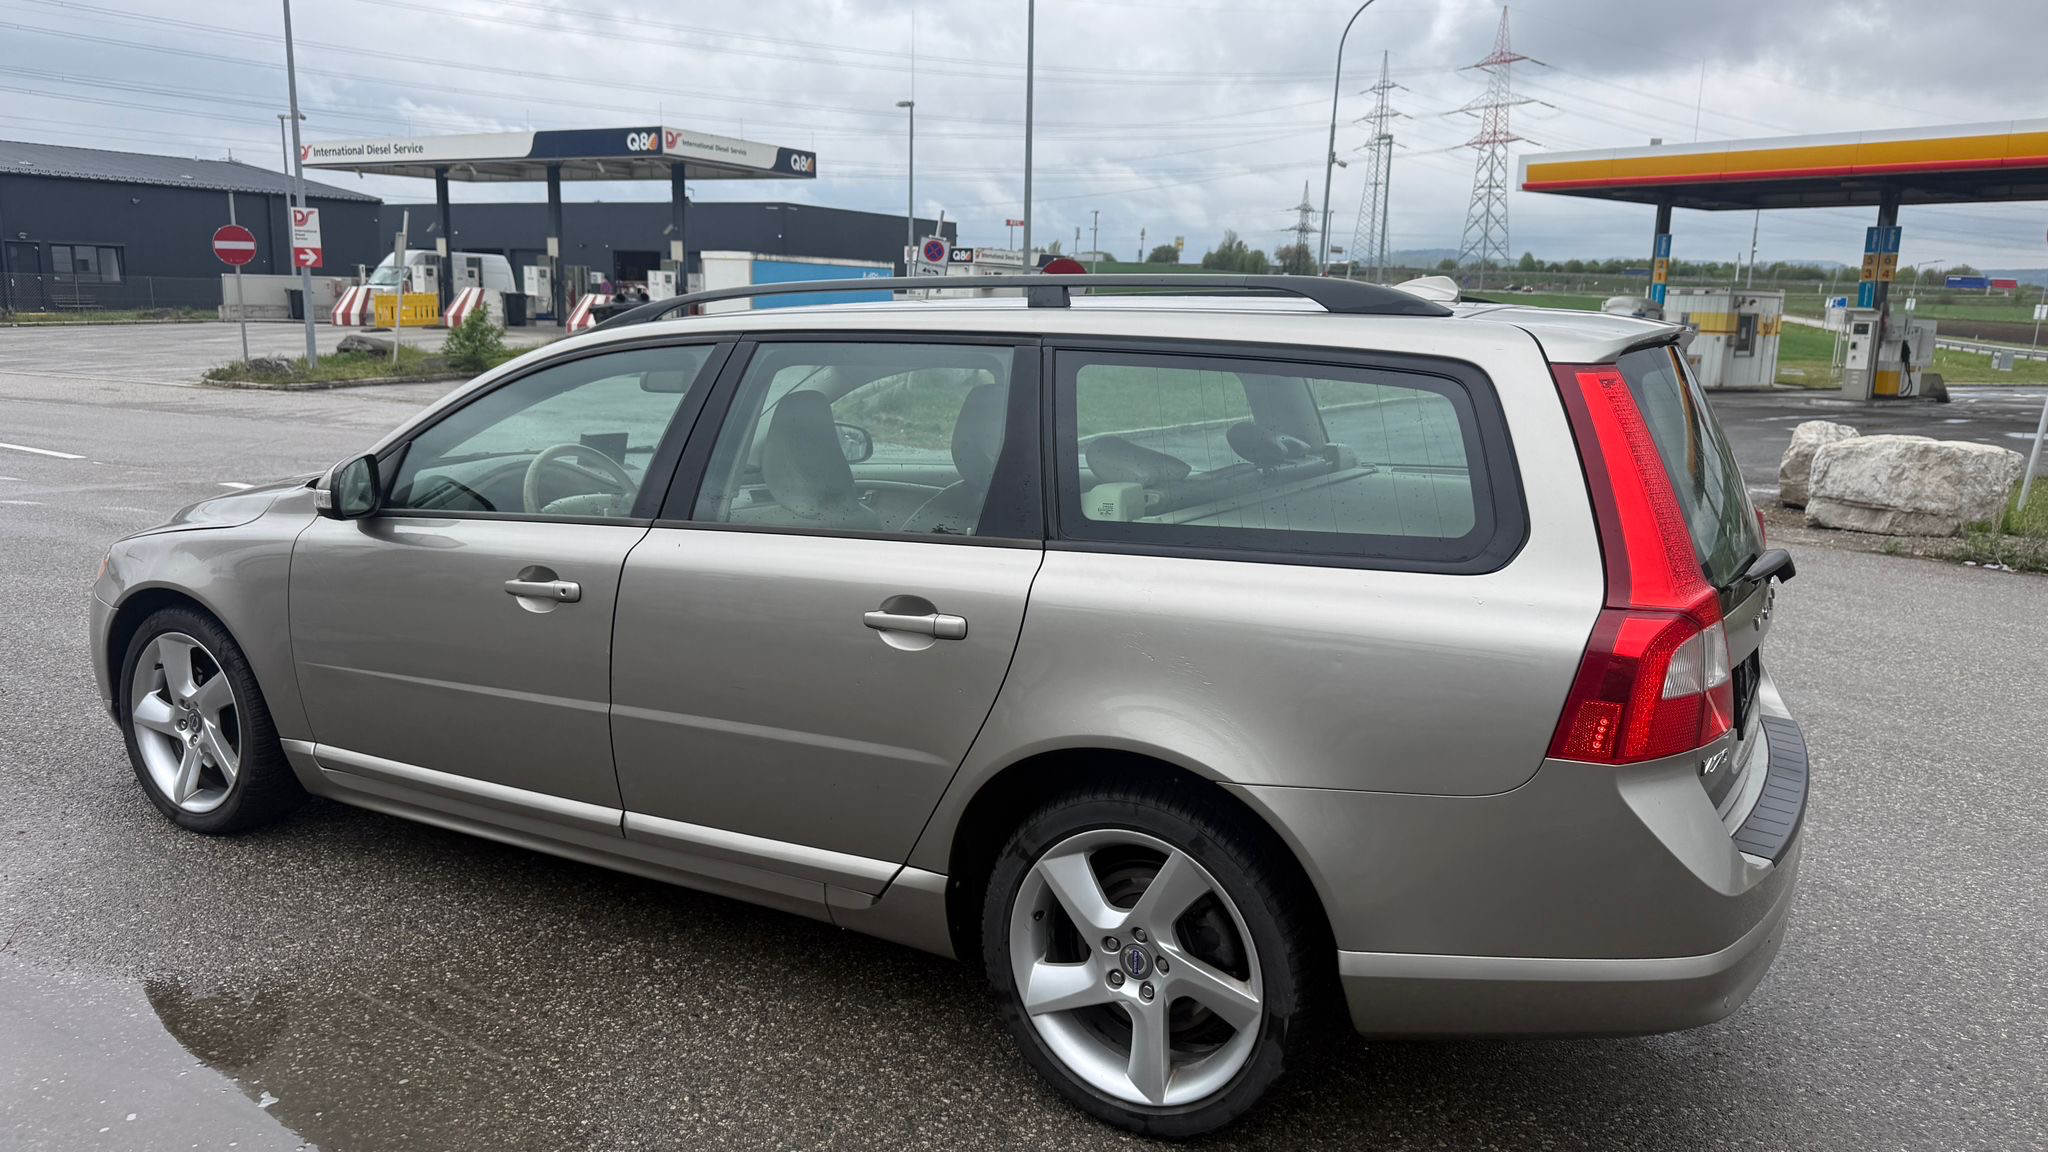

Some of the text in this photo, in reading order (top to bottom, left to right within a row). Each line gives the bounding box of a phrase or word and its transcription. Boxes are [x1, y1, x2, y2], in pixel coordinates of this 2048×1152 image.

[627, 132, 648, 151] Q8
[313, 145, 364, 157] International
[366, 144, 391, 155] Diesel
[394, 143, 424, 154] Service
[790, 154, 807, 171] Q8
[952, 250, 966, 261] Q8
[1864, 268, 1872, 279] 3
